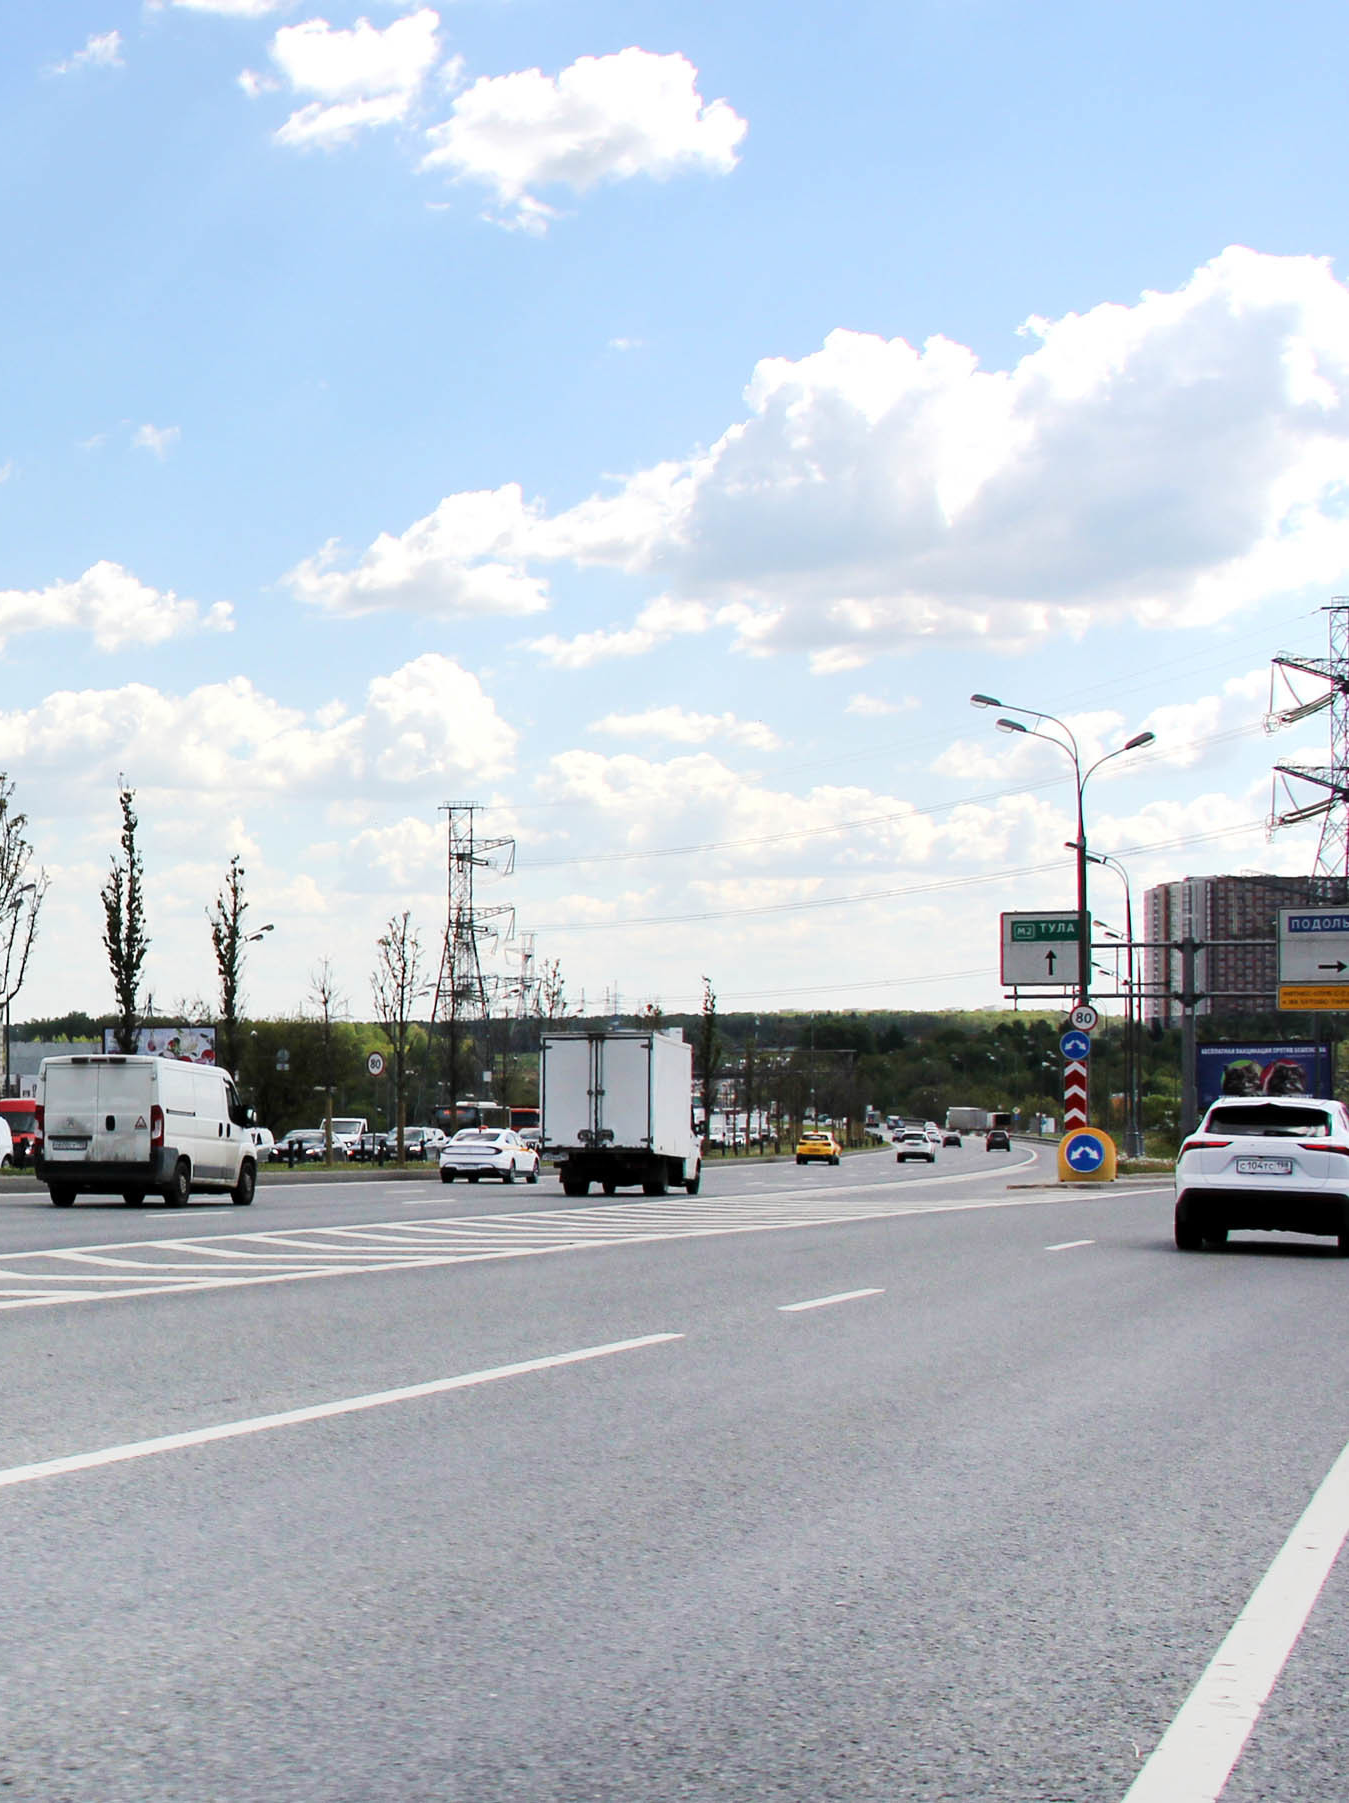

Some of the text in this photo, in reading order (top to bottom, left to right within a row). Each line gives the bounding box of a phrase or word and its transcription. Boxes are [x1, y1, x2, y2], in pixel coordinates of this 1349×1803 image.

[1040, 923, 1075, 934] ТУЛА
[1075, 1012, 1092, 1024] 80
[370, 1058, 381, 1070] 80
